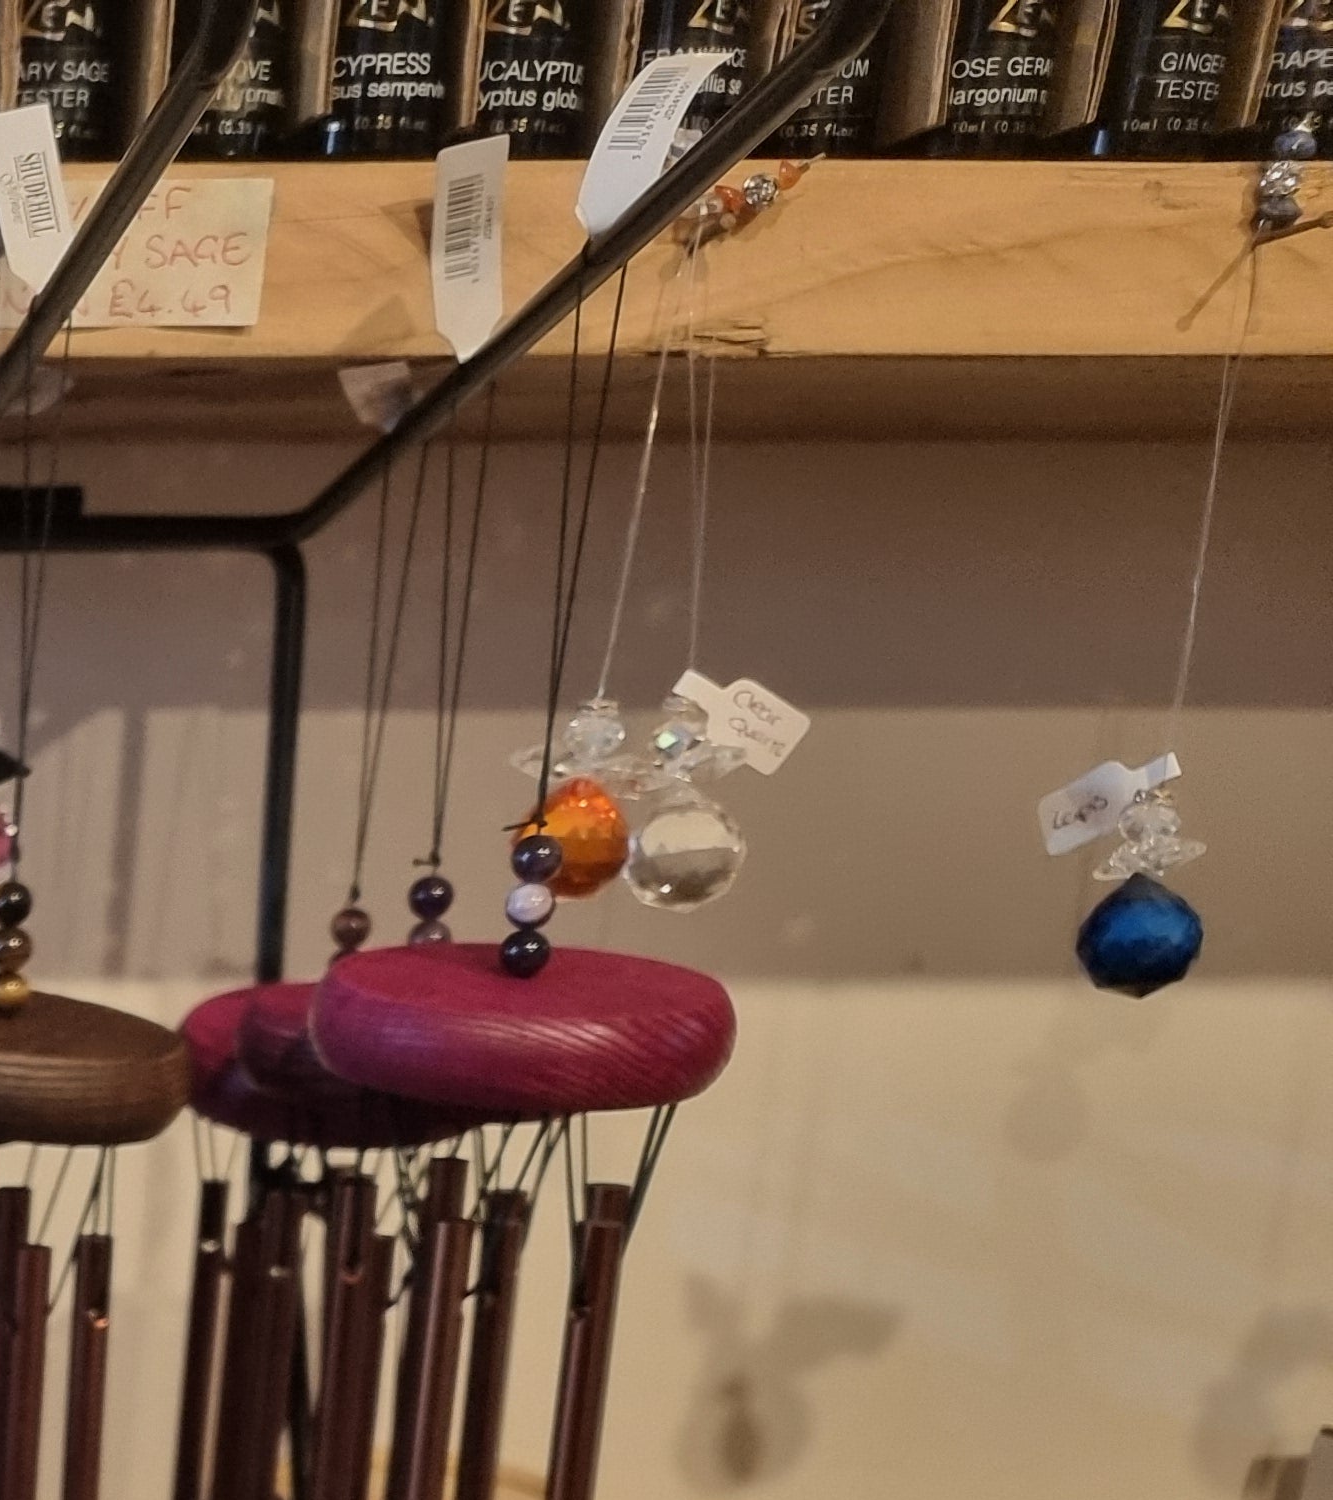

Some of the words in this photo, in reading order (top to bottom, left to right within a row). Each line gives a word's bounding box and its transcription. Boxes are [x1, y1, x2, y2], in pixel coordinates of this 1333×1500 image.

[60, 60, 110, 83] SAGE
[333, 52, 432, 79] CYPRESS
[951, 56, 1002, 79] OSE
[19, 88, 91, 109] ESTER
[17, 151, 56, 238] SHUDEHILL
[144, 231, 251, 270] SAGE
